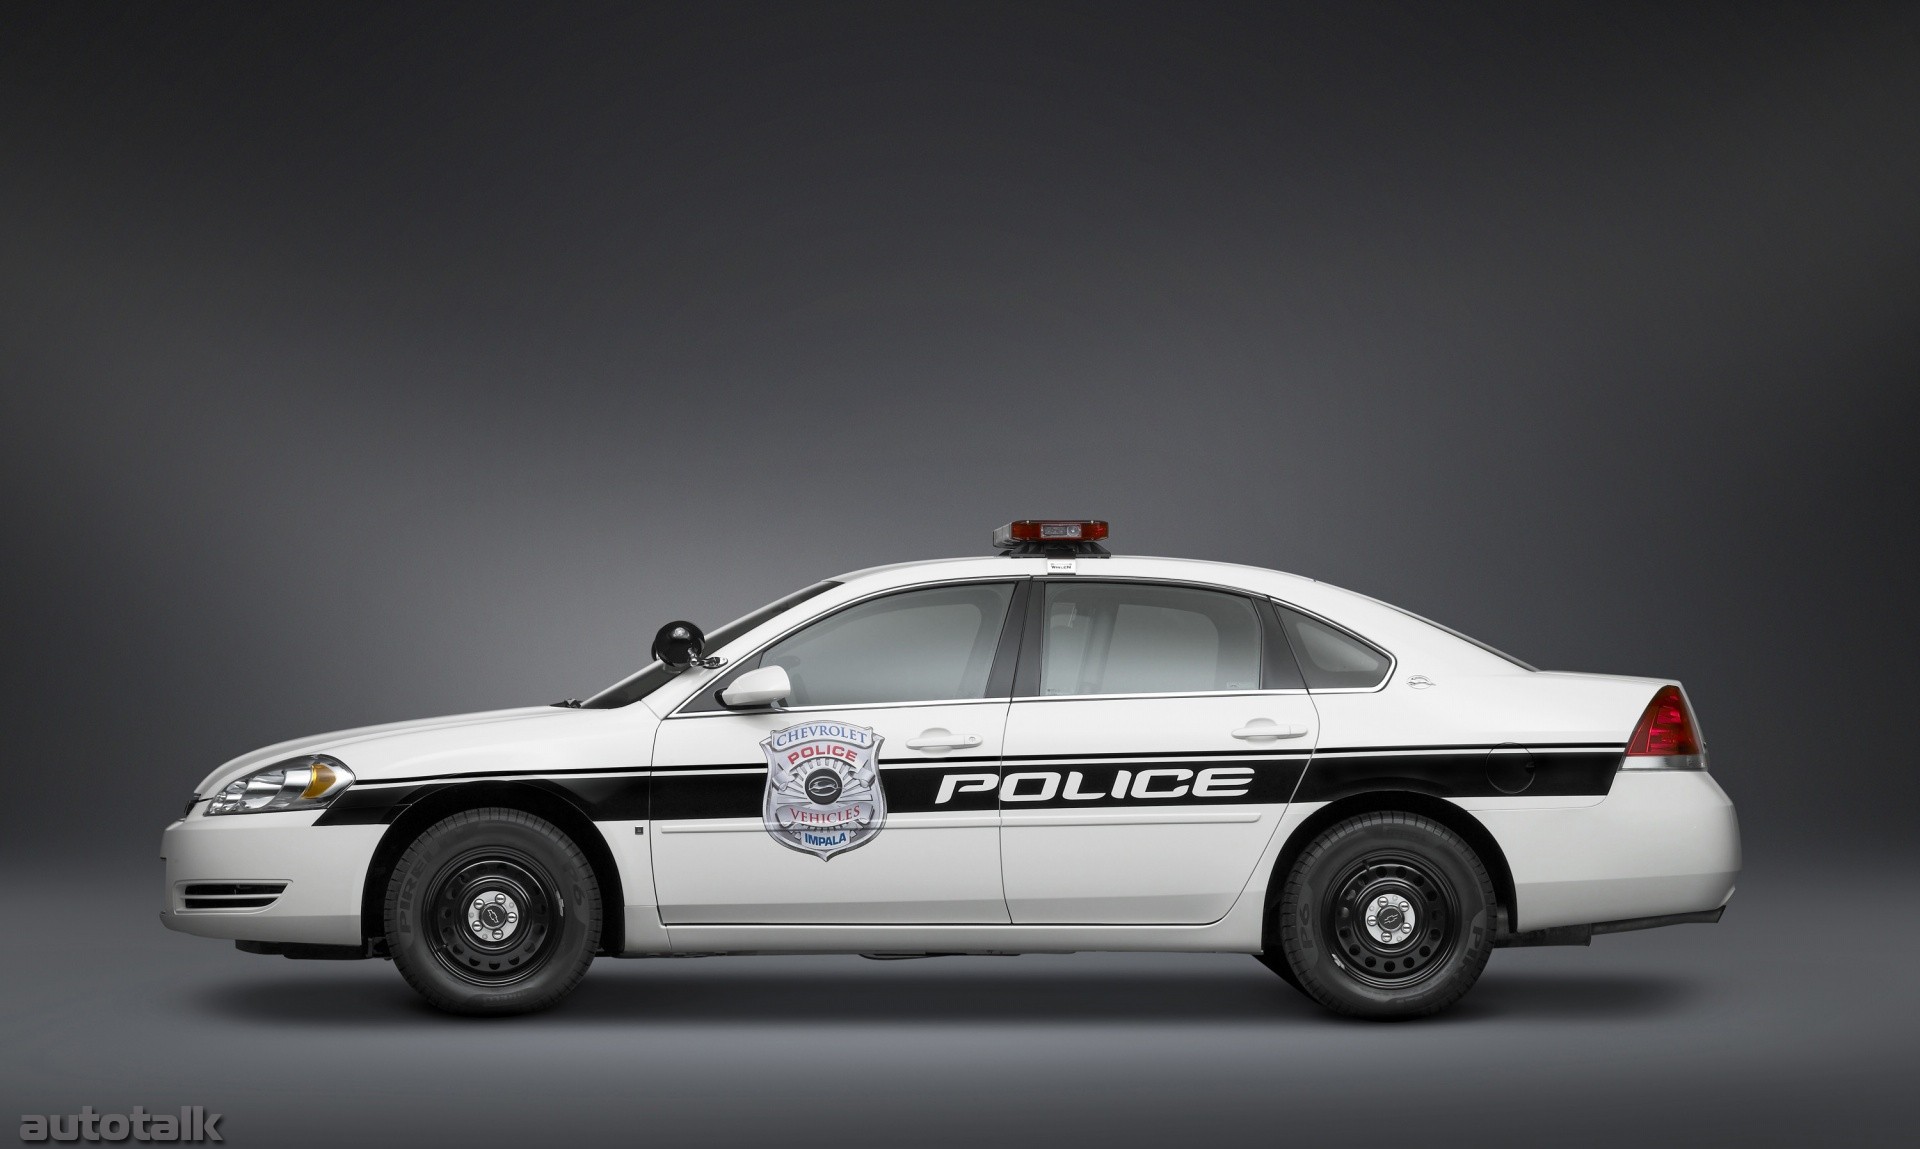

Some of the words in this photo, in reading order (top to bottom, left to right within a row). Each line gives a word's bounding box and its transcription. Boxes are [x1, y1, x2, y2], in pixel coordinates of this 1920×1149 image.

[776, 725, 868, 747] CHEVROLET
[787, 745, 858, 765] POLICE
[934, 767, 1255, 804] POLICE
[789, 805, 861, 823] VEHICLES
[804, 832, 847, 847] IMPALA
[1298, 903, 1314, 949] P6
